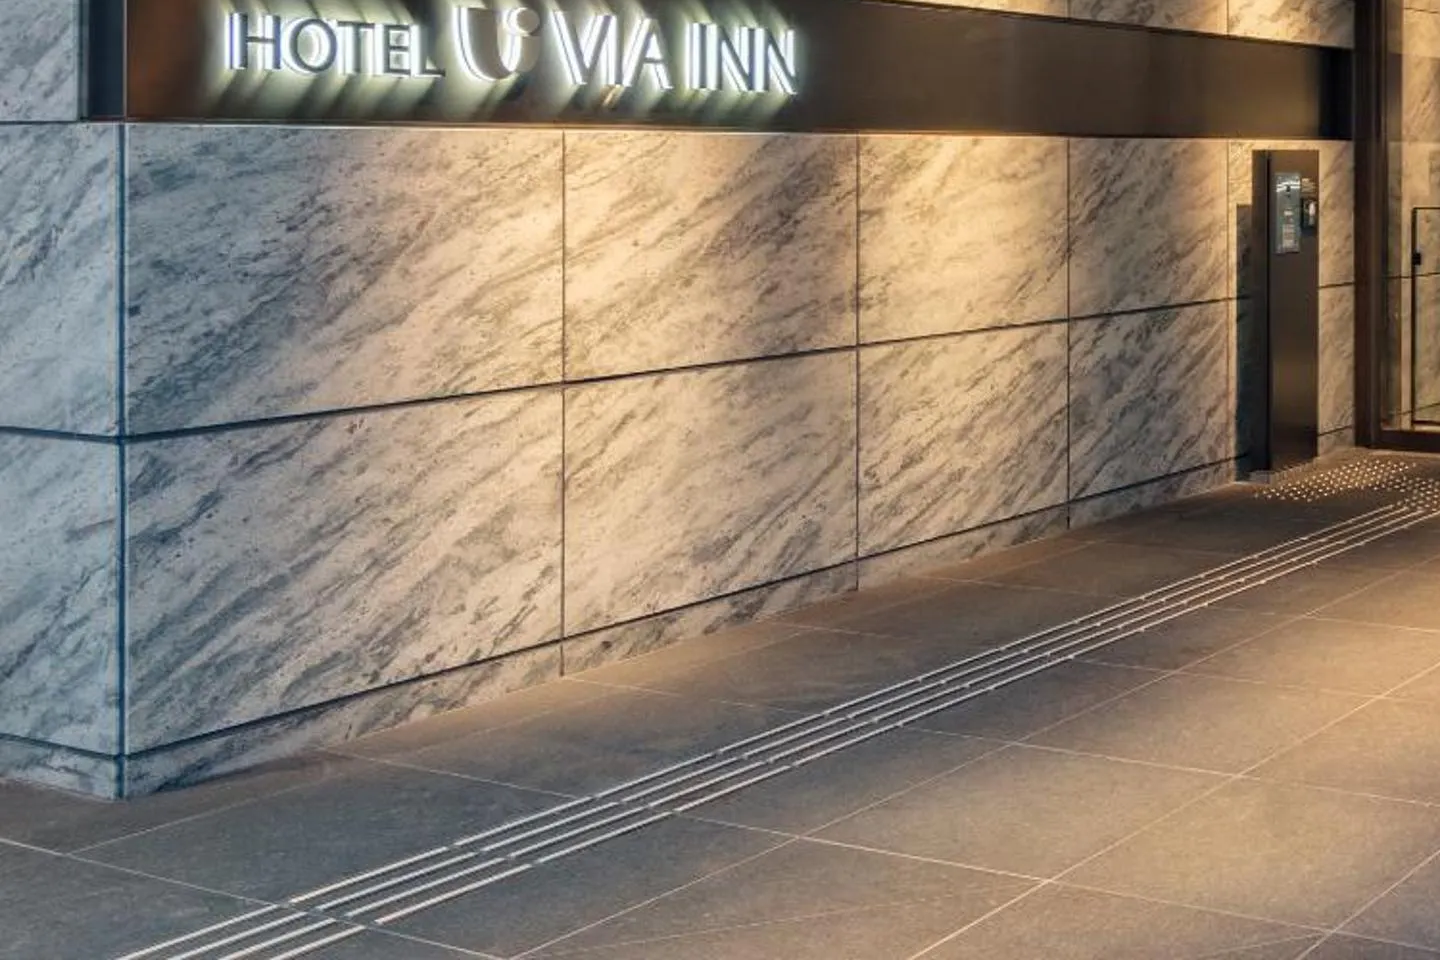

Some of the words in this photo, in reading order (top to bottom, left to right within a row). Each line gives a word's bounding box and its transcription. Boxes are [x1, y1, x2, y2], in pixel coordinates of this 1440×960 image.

[226, 12, 446, 78] HOTEL
[549, 10, 673, 89] VIA
[685, 22, 797, 95] INN
